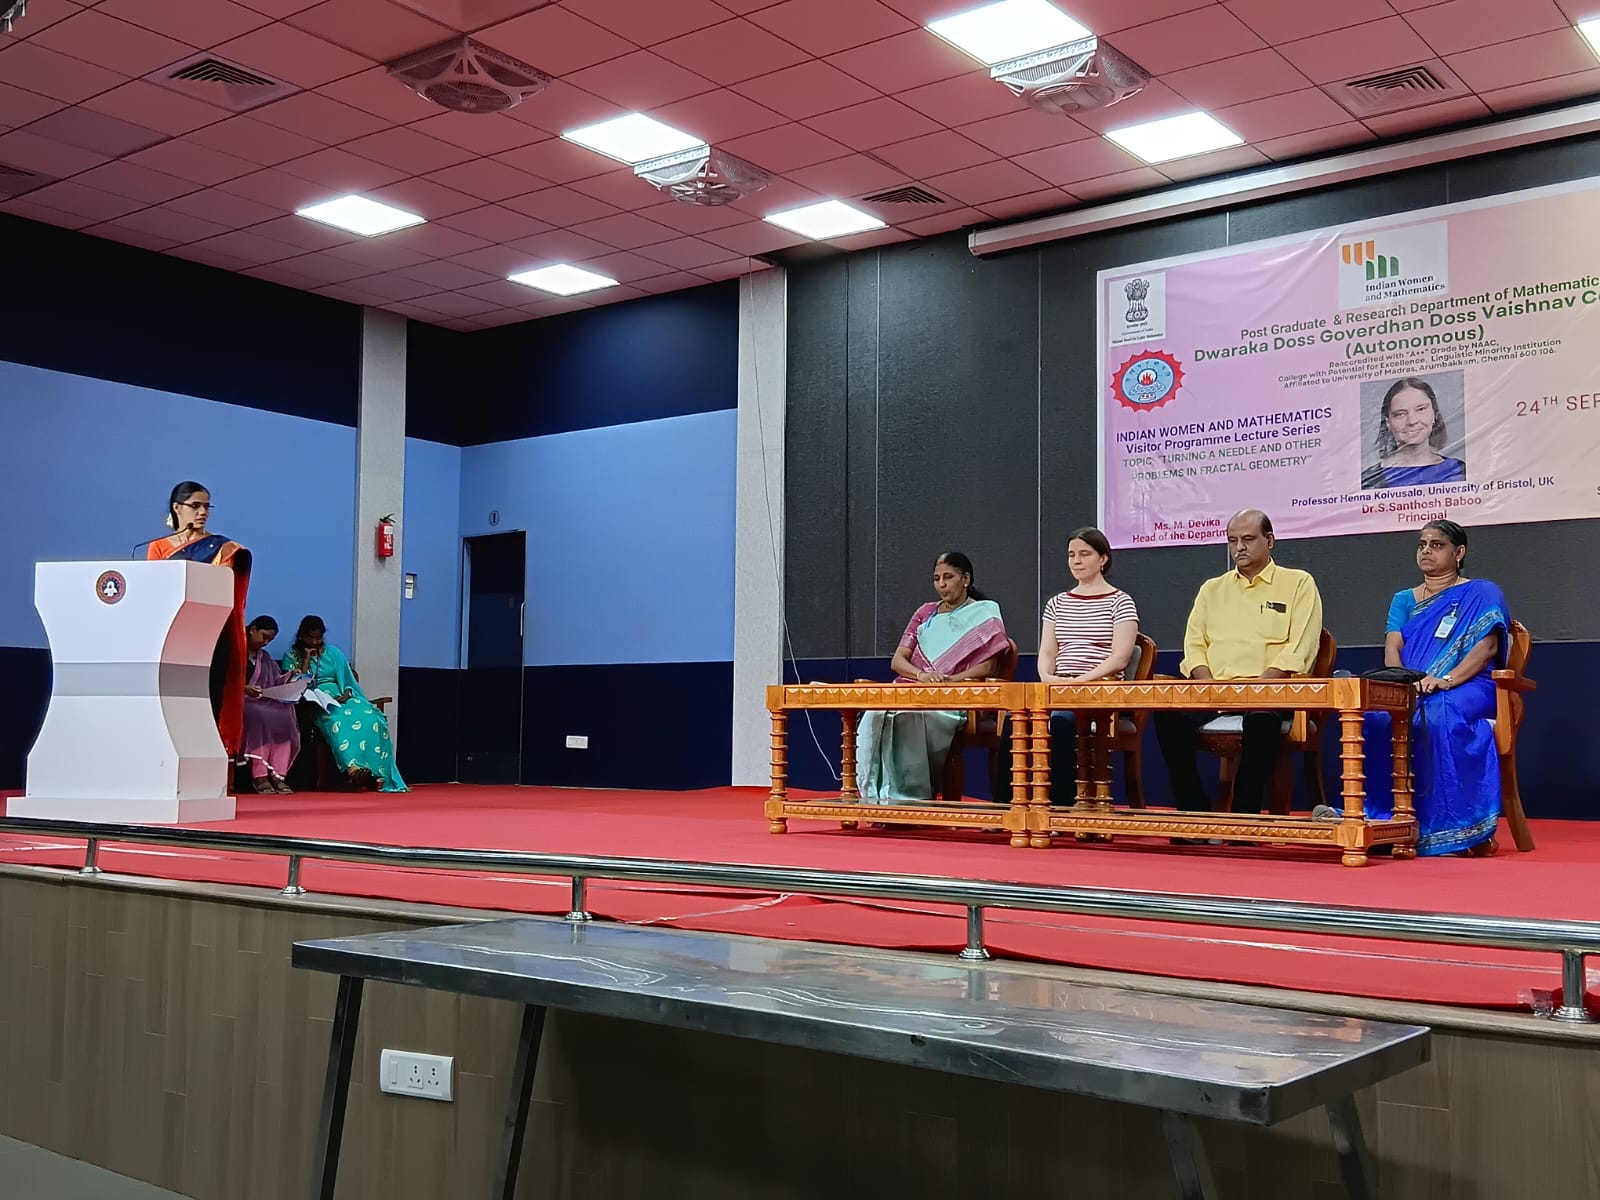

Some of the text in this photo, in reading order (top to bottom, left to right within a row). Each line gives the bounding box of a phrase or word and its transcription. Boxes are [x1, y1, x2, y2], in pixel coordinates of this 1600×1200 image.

[1365, 283, 1446, 301] and Mathematics
[1366, 275, 1434, 292] Indian Women
[1241, 275, 1600, 340] Post Graduate & Research Department of Mathematic
[1194, 290, 1600, 362] Dwaraka Doss Goverdhan Doss Vaishnav C
[1345, 325, 1484, 359] (Autonomous)
[1278, 373, 1308, 383] College
[1309, 369, 1327, 378] with
[1328, 364, 1365, 376] Potential
[1366, 361, 1378, 371] for
[1431, 350, 1473, 362] Linguistic
[1475, 344, 1512, 356] Minority
[1513, 338, 1561, 350] Institution
[1284, 378, 1320, 389] Affiliated
[1332, 371, 1373, 383] University
[1374, 369, 1383, 377] of
[1480, 352, 1518, 363] Chennai
[1519, 349, 1537, 358] 600
[1329, 354, 1384, 369] Reaccredited
[1386, 352, 1404, 361] with
[1431, 345, 1457, 355] Grade
[1459, 343, 1469, 352] by
[1116, 407, 1333, 443] INDIAN WOMEN AND MATHEMATICS
[1126, 423, 1321, 454] Visitor Programme Lecture Series
[1208, 449, 1216, 458] A
[1218, 445, 1258, 458] NEEDLE
[1259, 441, 1282, 454] AND
[1284, 438, 1322, 451] OTHER
[1131, 468, 1184, 481] PROBLEMS
[1186, 467, 1197, 476] IN
[1200, 463, 1246, 475] FRACTAL
[1291, 496, 1338, 507] Professor
[1340, 493, 1371, 503] Henna
[1428, 483, 1480, 495] University
[1483, 480, 1494, 491] of
[1497, 478, 1535, 490] Bristol,
[1538, 476, 1554, 486] UK
[1362, 496, 1482, 514] Dr.S.Santhosh Baboo
[1398, 509, 1447, 523] Principal
[1132, 533, 1156, 543] Head
[1159, 533, 1169, 541] of
[1170, 531, 1185, 540] the
[1154, 521, 1171, 531] Ms.
[1188, 518, 1221, 529] Devika
